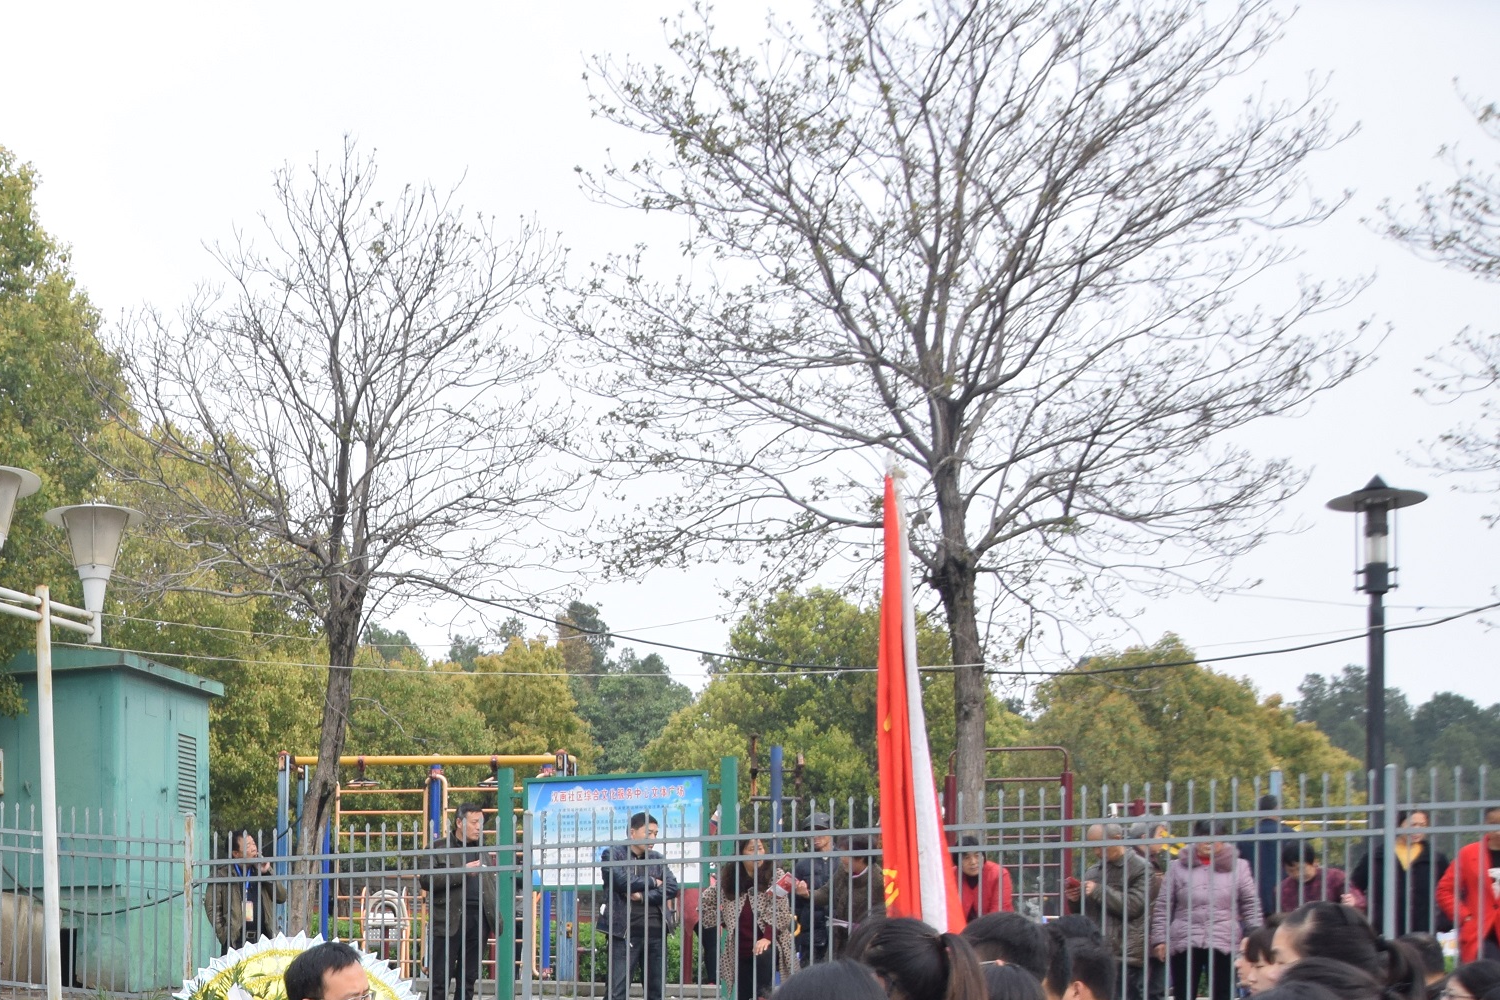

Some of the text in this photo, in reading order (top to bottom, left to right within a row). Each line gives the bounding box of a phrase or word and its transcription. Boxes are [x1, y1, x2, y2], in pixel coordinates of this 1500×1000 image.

[550, 785, 686, 803] 汉画社区综合文化服务中心文体广场
